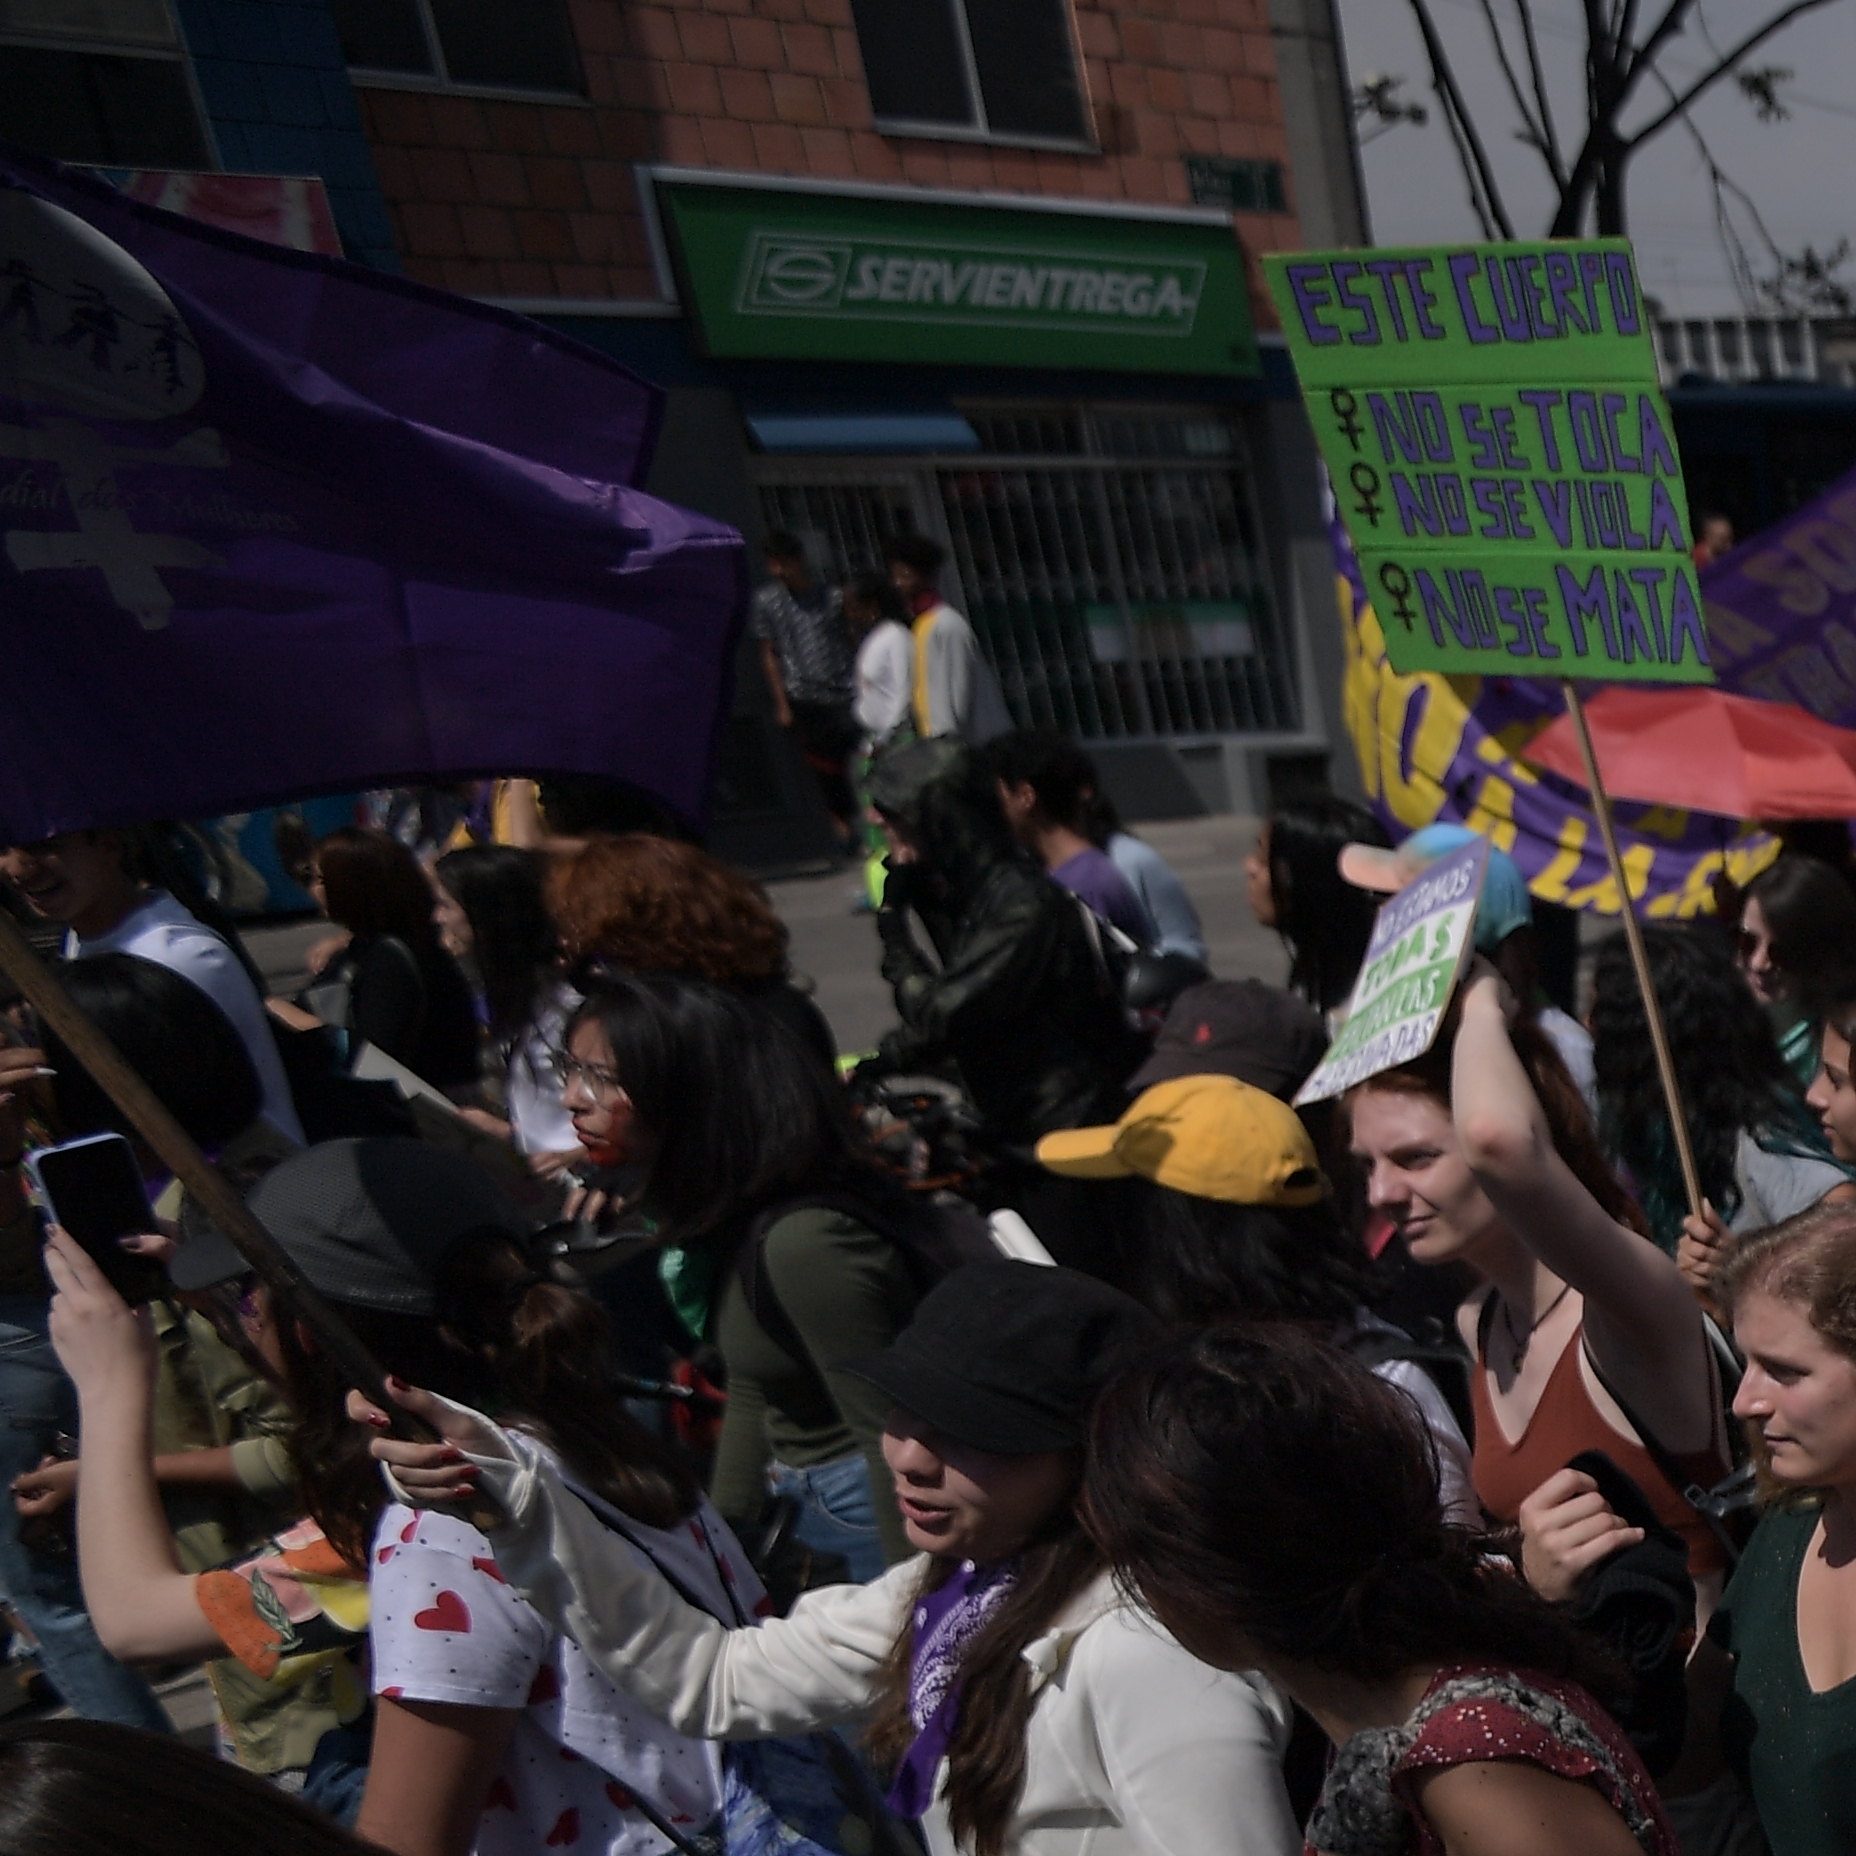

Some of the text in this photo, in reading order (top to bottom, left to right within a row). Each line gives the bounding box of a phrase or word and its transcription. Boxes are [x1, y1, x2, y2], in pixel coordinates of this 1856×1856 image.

[846, 254, 1188, 318] SERVIENTREGA
[1286, 250, 1643, 346] ESTE CUERPO
[1366, 390, 1678, 478] NO SE TOCA
[1388, 472, 1688, 552] NO SE VIOLA
[1413, 563, 1713, 665] NO SE MATA
